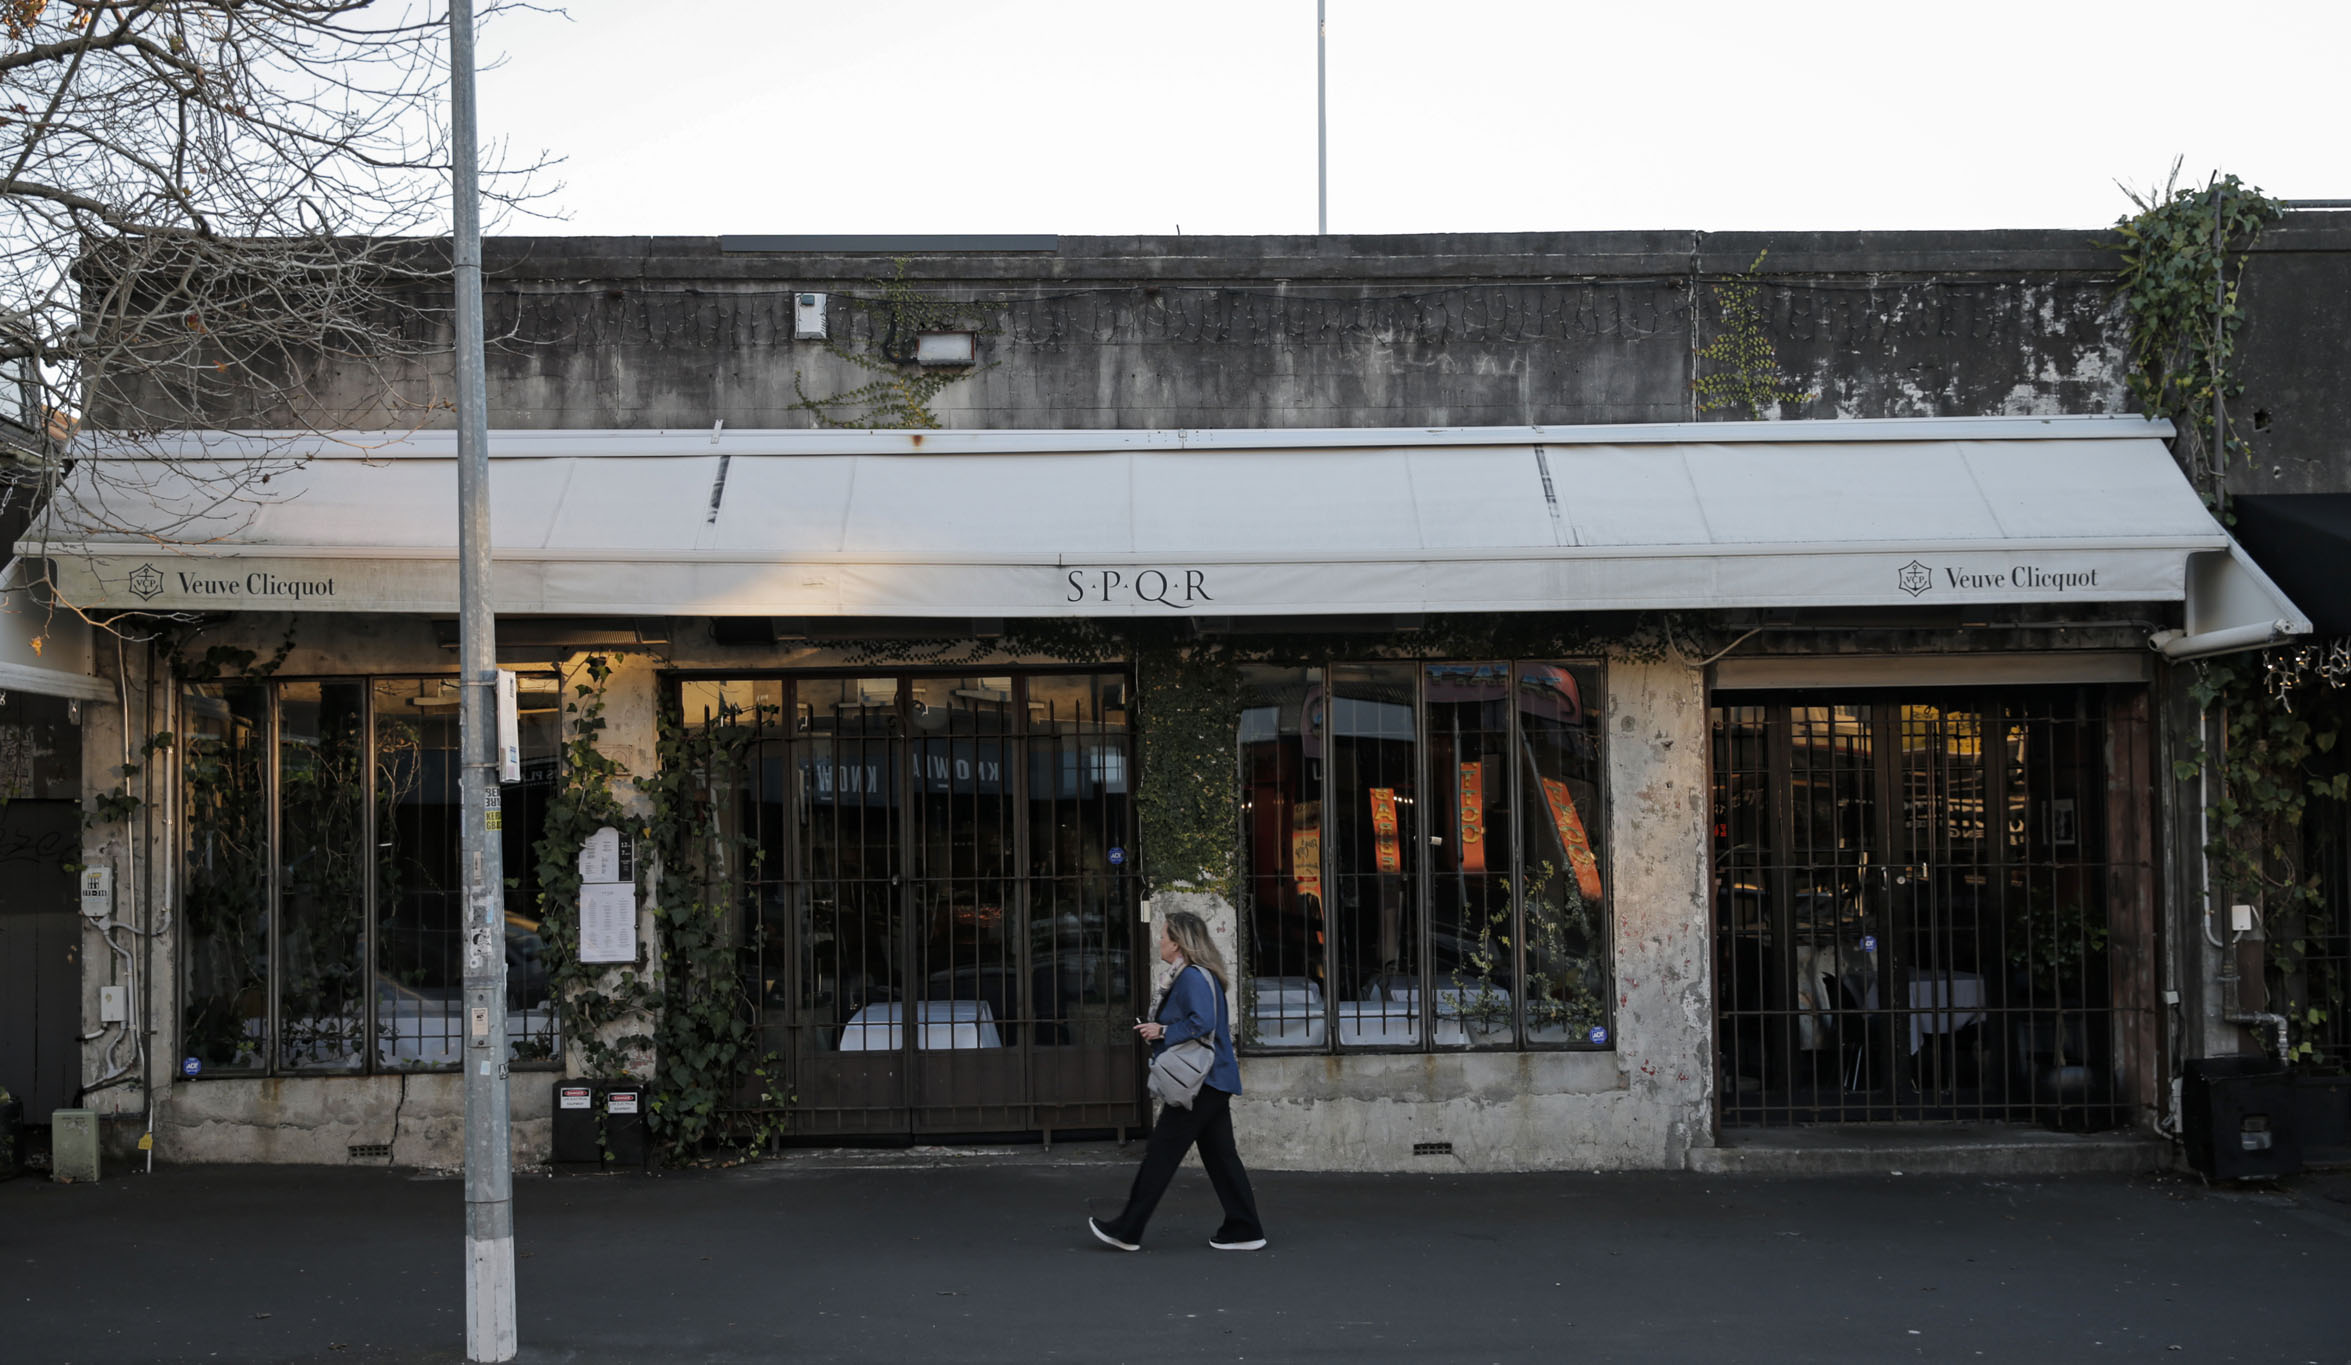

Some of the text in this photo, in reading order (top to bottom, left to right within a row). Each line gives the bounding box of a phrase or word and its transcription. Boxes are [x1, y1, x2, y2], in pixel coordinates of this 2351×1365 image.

[177, 572, 335, 600] Veuve Clicquot
[1943, 566, 2099, 592] Veuve Clicquot
